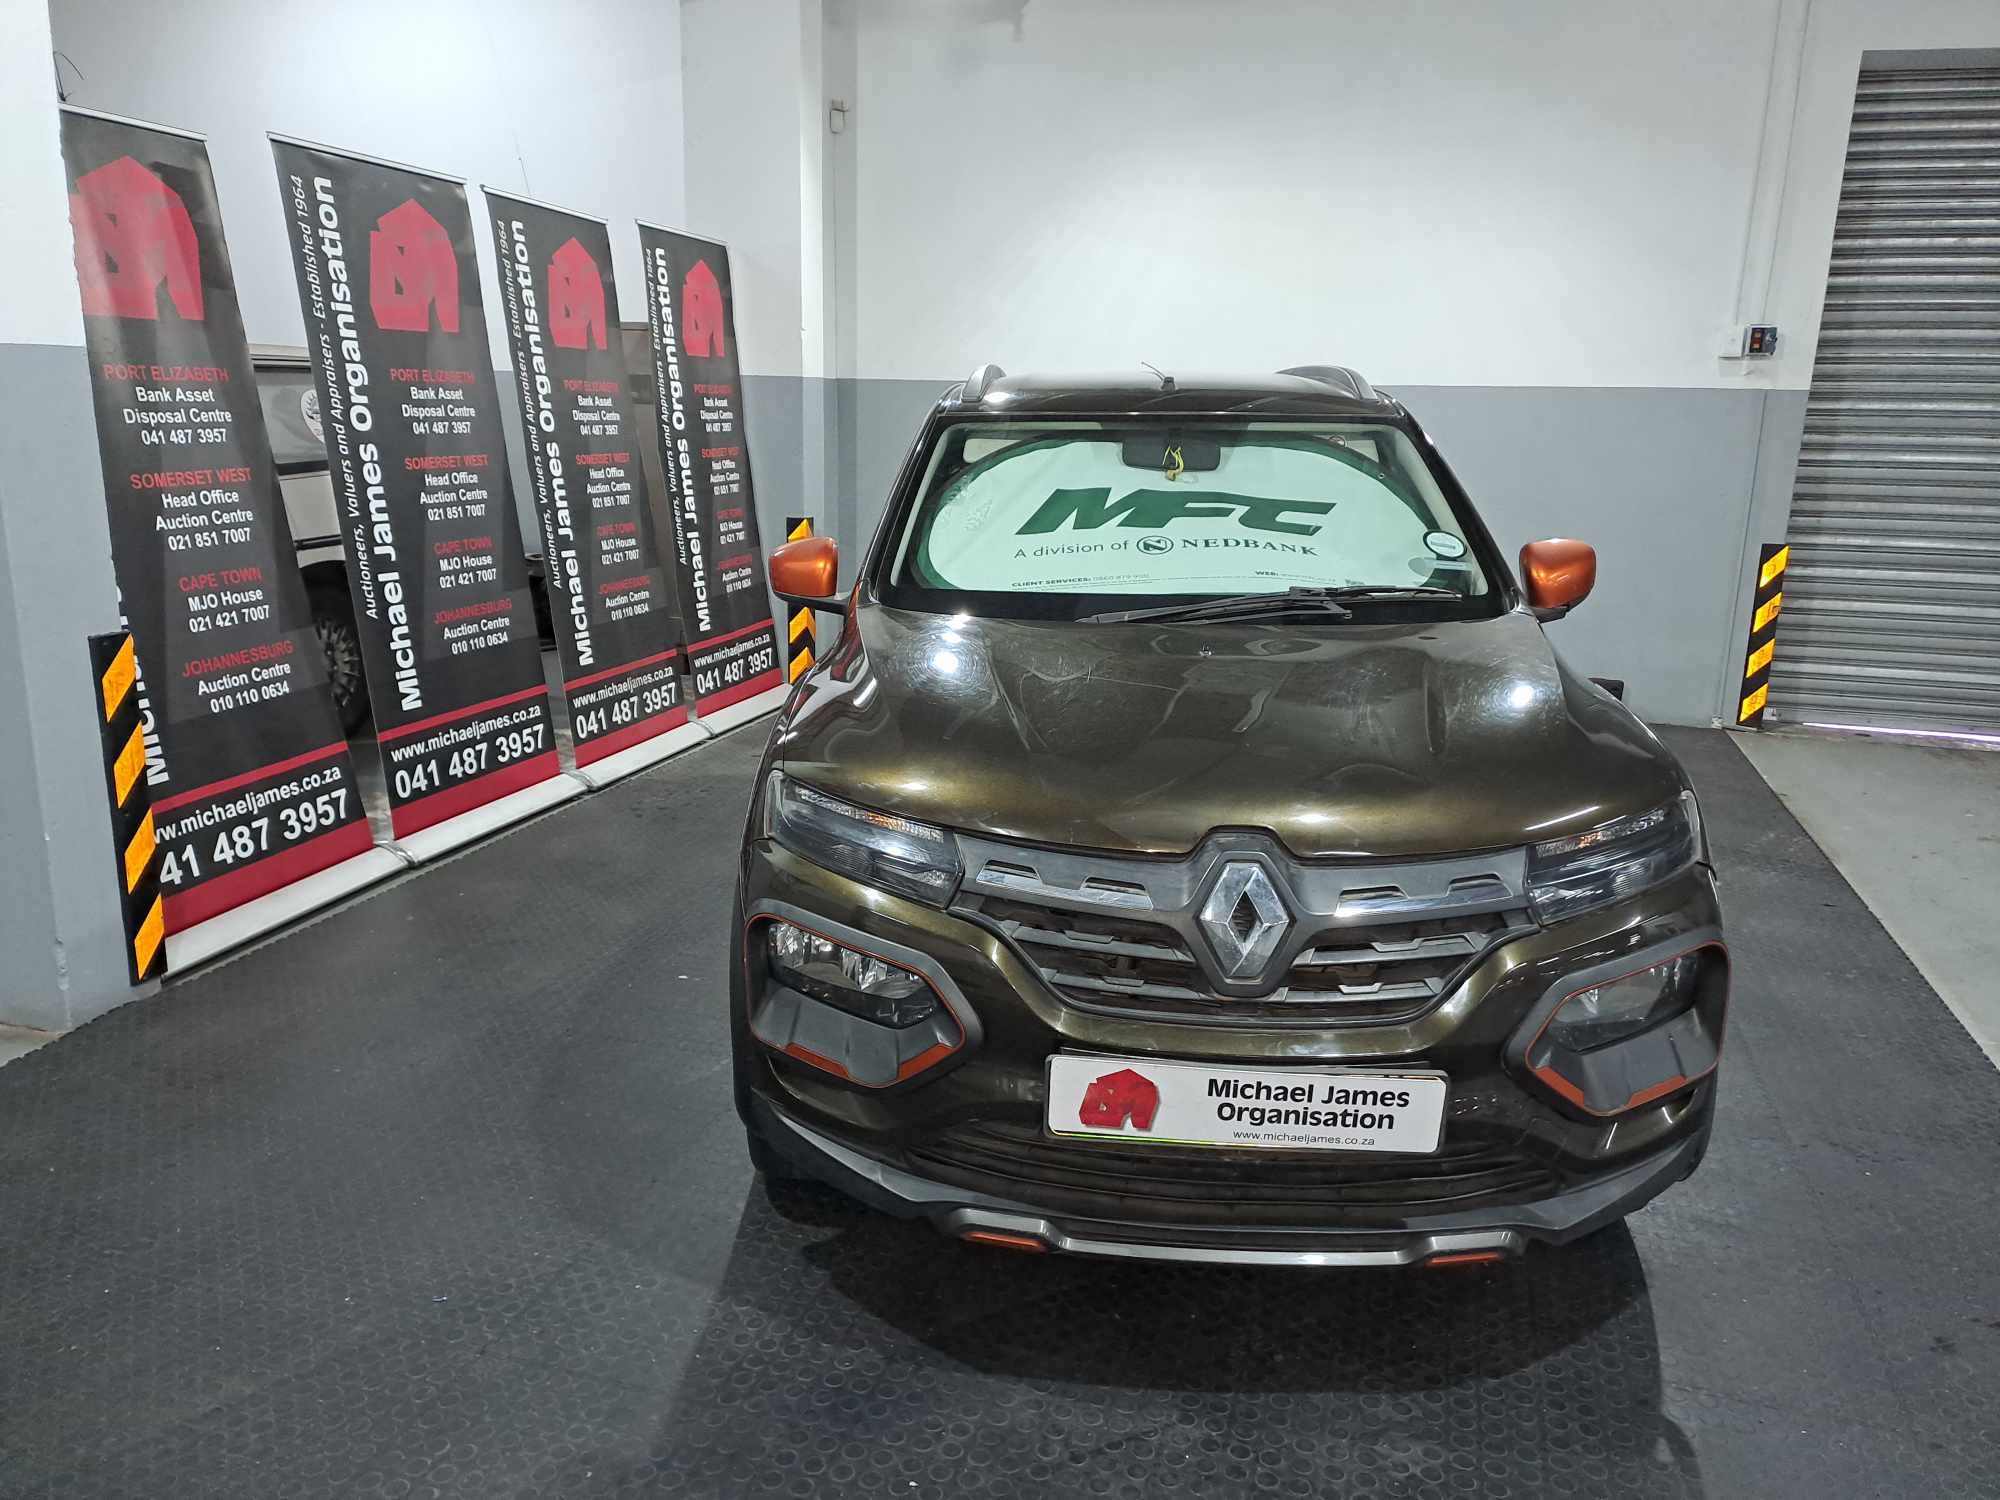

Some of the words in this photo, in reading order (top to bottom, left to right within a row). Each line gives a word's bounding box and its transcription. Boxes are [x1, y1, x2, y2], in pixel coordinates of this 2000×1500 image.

[290, 174, 308, 217] 1964
[298, 222, 326, 320] Established
[313, 176, 372, 432] Organisation
[502, 258, 521, 339] Established
[511, 220, 555, 433] Organisation
[655, 248, 685, 431] Organisation
[104, 364, 148, 382] PORT
[152, 366, 229, 383] ELIZABETH
[320, 333, 344, 420] Appraisers
[390, 368, 419, 381] PORT
[517, 350, 535, 423] Appraisers
[136, 387, 172, 402] Bank
[176, 388, 214, 402] Asset
[410, 386, 437, 400] Bank
[438, 387, 464, 400] Asset
[124, 409, 186, 426] Disposal
[190, 409, 232, 423] Centre
[402, 404, 445, 419] Disposal
[447, 404, 476, 417] Centre
[572, 410, 600, 422] Disposal
[142, 431, 166, 445] 041
[170, 430, 192, 444] 487
[199, 428, 227, 443] 3957
[331, 422, 349, 455] and
[412, 422, 430, 434] 041
[432, 422, 448, 434] 487
[452, 422, 471, 434] 3957
[528, 425, 539, 451] and
[662, 424, 671, 448] and
[404, 456, 460, 470] SOMERSET
[464, 454, 488, 466] WEST
[606, 467, 624, 477] Office
[667, 450, 677, 493] Valuers
[131, 471, 210, 489] SOMERSET
[214, 468, 252, 484] WEST
[341, 458, 360, 518] Valuers
[425, 474, 449, 486] Head
[452, 472, 478, 484] Office
[534, 455, 547, 504] Valuers
[546, 441, 574, 541] James
[586, 483, 610, 494] Auction
[677, 439, 697, 524] James
[162, 491, 196, 509] Head
[201, 489, 238, 506] Office
[358, 442, 397, 562] James
[420, 490, 457, 504] Auction
[459, 488, 488, 500] Centre
[156, 511, 209, 530] Auction
[214, 508, 253, 525] Centre
[428, 508, 444, 520] 021
[447, 506, 463, 519] 851
[466, 504, 485, 517] 7007
[1014, 487, 1337, 536] MFC
[168, 533, 192, 550] 021
[195, 532, 219, 548] 851
[224, 528, 251, 545] 7007
[543, 509, 562, 589] Auctioneers,
[616, 538, 636, 548] House
[1014, 548, 1026, 558] A
[1033, 544, 1104, 557] division
[1111, 540, 1129, 550] of
[1182, 537, 1319, 556] NEDBANK
[352, 523, 379, 620] Auctioneers,
[440, 557, 460, 571] MJO
[463, 555, 492, 568] House
[180, 573, 216, 592] CAPE
[220, 568, 262, 585] TOWN
[440, 576, 456, 588] 021
[458, 573, 474, 585] 421
[476, 568, 497, 582] 7007
[686, 531, 711, 631] Michael
[188, 594, 216, 612] MJO
[220, 588, 262, 606] House
[561, 550, 594, 666] Michael
[606, 595, 628, 608] Auction
[189, 617, 212, 632] 021
[216, 612, 238, 628] 421
[242, 606, 270, 623] 7007
[443, 623, 479, 640] Auction
[481, 616, 510, 631] Centre
[378, 572, 422, 712] Michael
[451, 640, 468, 655] 010
[470, 636, 485, 650] 110
[487, 632, 508, 647] 0634
[694, 633, 770, 668] www.michaeljames.co.za
[182, 640, 294, 678] JOHANNESBURG
[696, 668, 720, 694] 041
[724, 659, 744, 683] 487
[748, 648, 772, 674] 3957
[198, 672, 247, 696] Auction
[251, 662, 290, 683] Centre
[573, 665, 673, 709] www.michaeljames.co.za
[211, 697, 232, 713] 010
[237, 691, 258, 706] 110
[262, 682, 290, 702] 0634
[576, 707, 607, 739] 041
[612, 695, 638, 725] 487
[642, 682, 676, 714] 3957
[390, 704, 541, 762] www.michaeljames.co.za
[395, 760, 440, 799] 041
[449, 743, 487, 778] 487
[496, 724, 544, 763] 3957
[160, 844, 200, 885] 41
[213, 818, 270, 864] 487
[280, 788, 347, 840] 3957
[1208, 1078, 1314, 1103] Michael
[1321, 1084, 1410, 1108] James
[1217, 1102, 1395, 1130] Organisation
[1232, 1130, 1376, 1146] www.michaeljames.co.za
